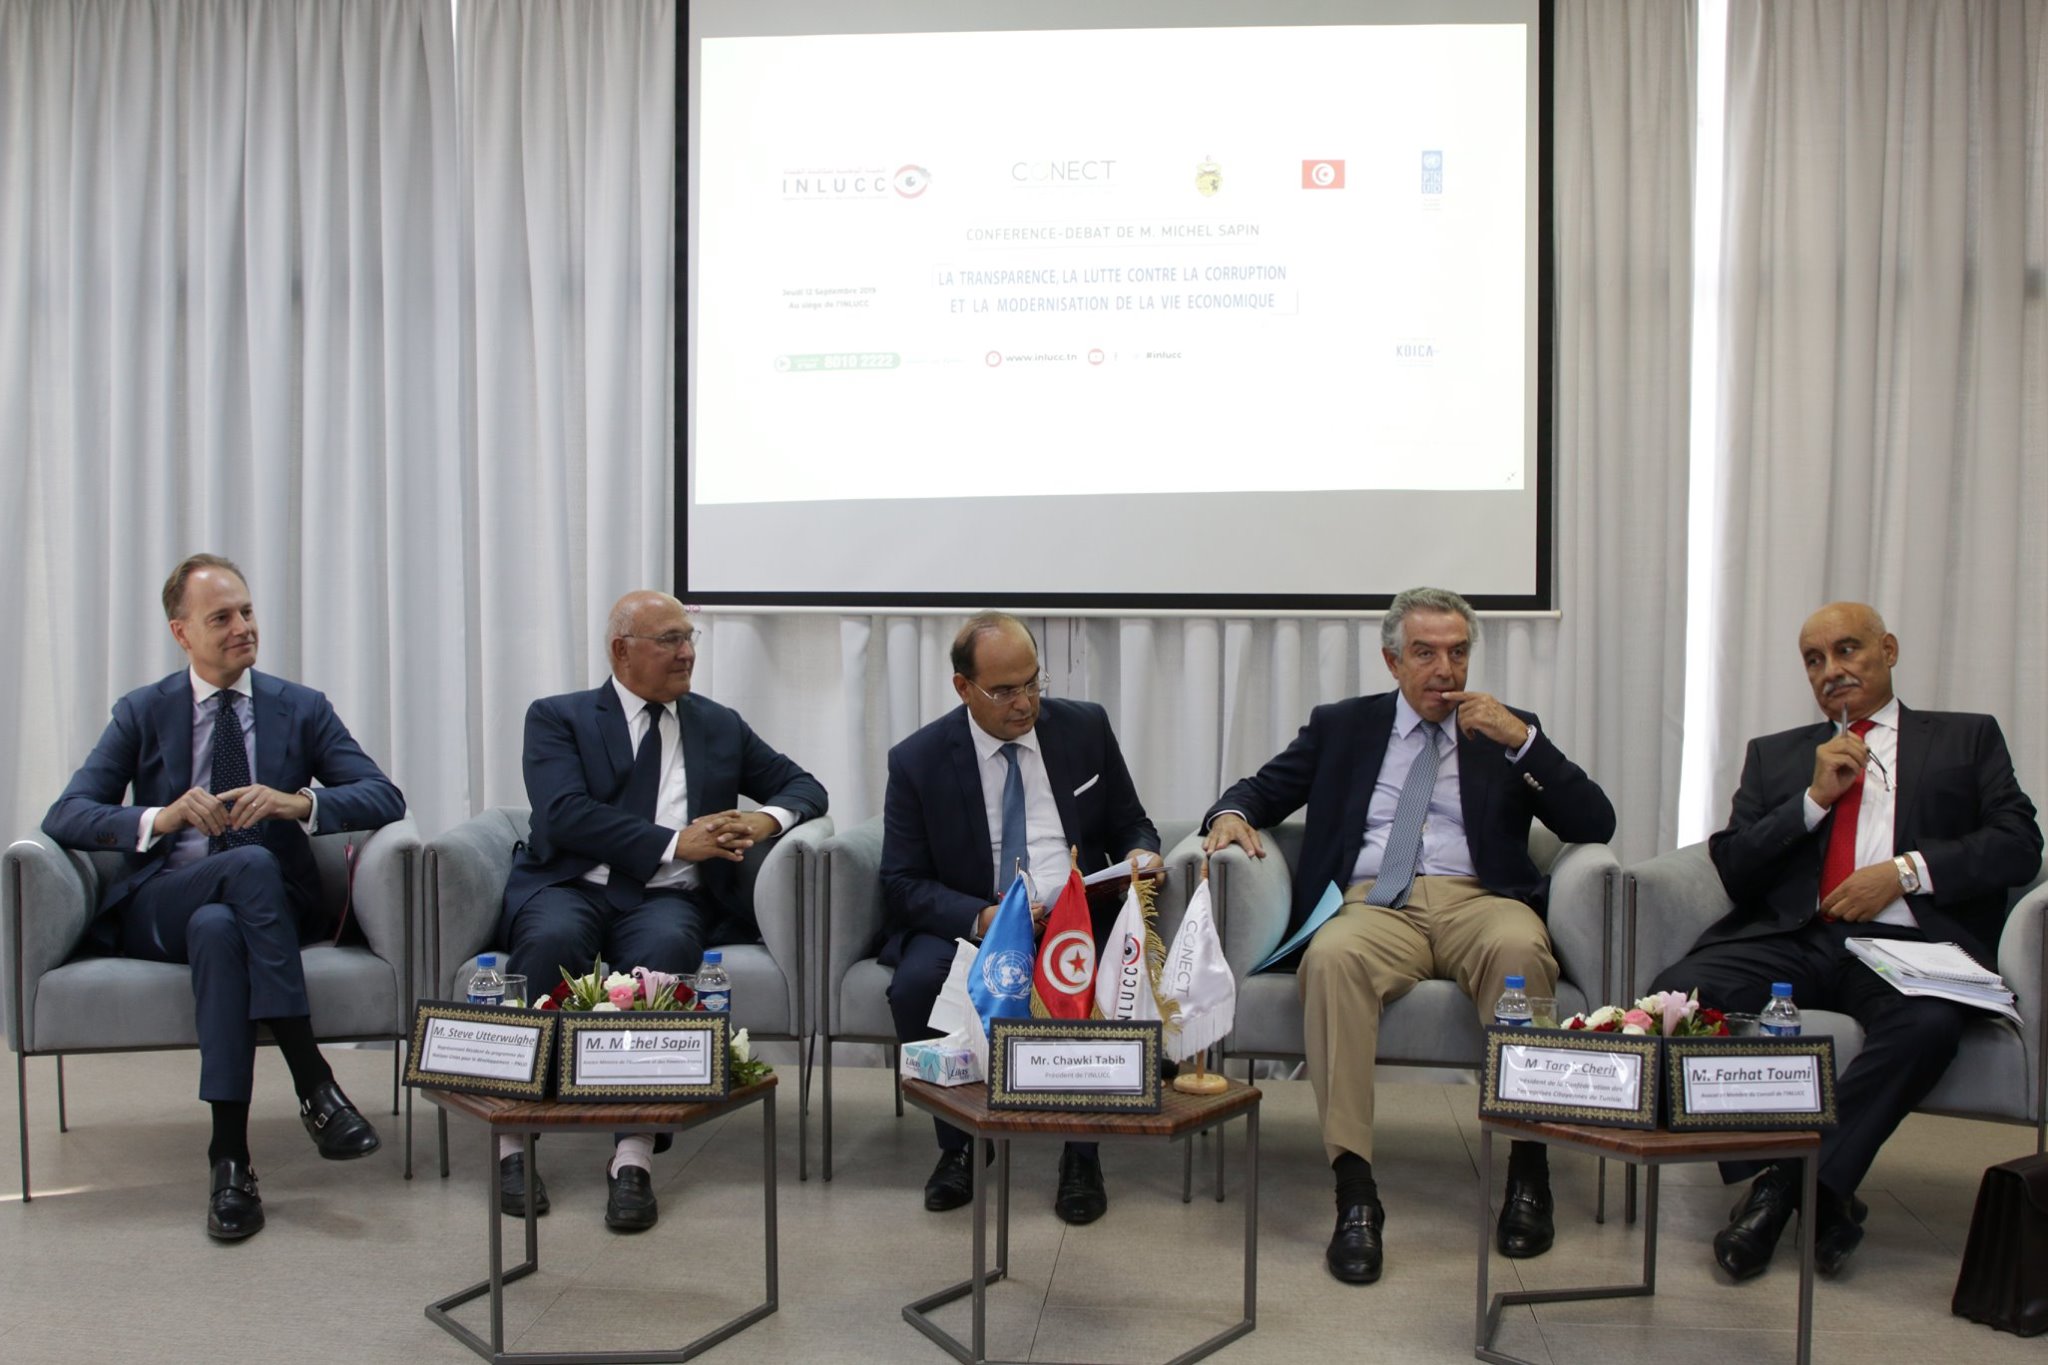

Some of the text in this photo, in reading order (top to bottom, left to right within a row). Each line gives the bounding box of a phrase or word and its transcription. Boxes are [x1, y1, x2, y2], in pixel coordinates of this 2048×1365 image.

[782, 178, 886, 193] INLUCC
[966, 223, 1260, 241] CONFERENCE-DEBAT DE M. MICHEL SAPIN
[938, 265, 1287, 286] LA TRANSPARENCE, LA LUTTE CONTRE LA CORRUPTION
[950, 293, 1275, 313] ET LA MODERNISATION DE LA VIE ECONOMIQUE
[860, 354, 893, 367] 2222
[1005, 353, 1077, 363] www.inlucc.tn
[1146, 351, 1182, 359] #inlucc
[1176, 920, 1198, 997] CONECT
[1117, 967, 1138, 1020] NLUCC
[433, 1027, 535, 1046] M. Steve Utterwulghe
[585, 1036, 700, 1051] M. Mchel Sapin
[1030, 1055, 1125, 1065] Mr. Chawki Tabib
[1692, 1066, 1811, 1081] M. Farhat Toumi
